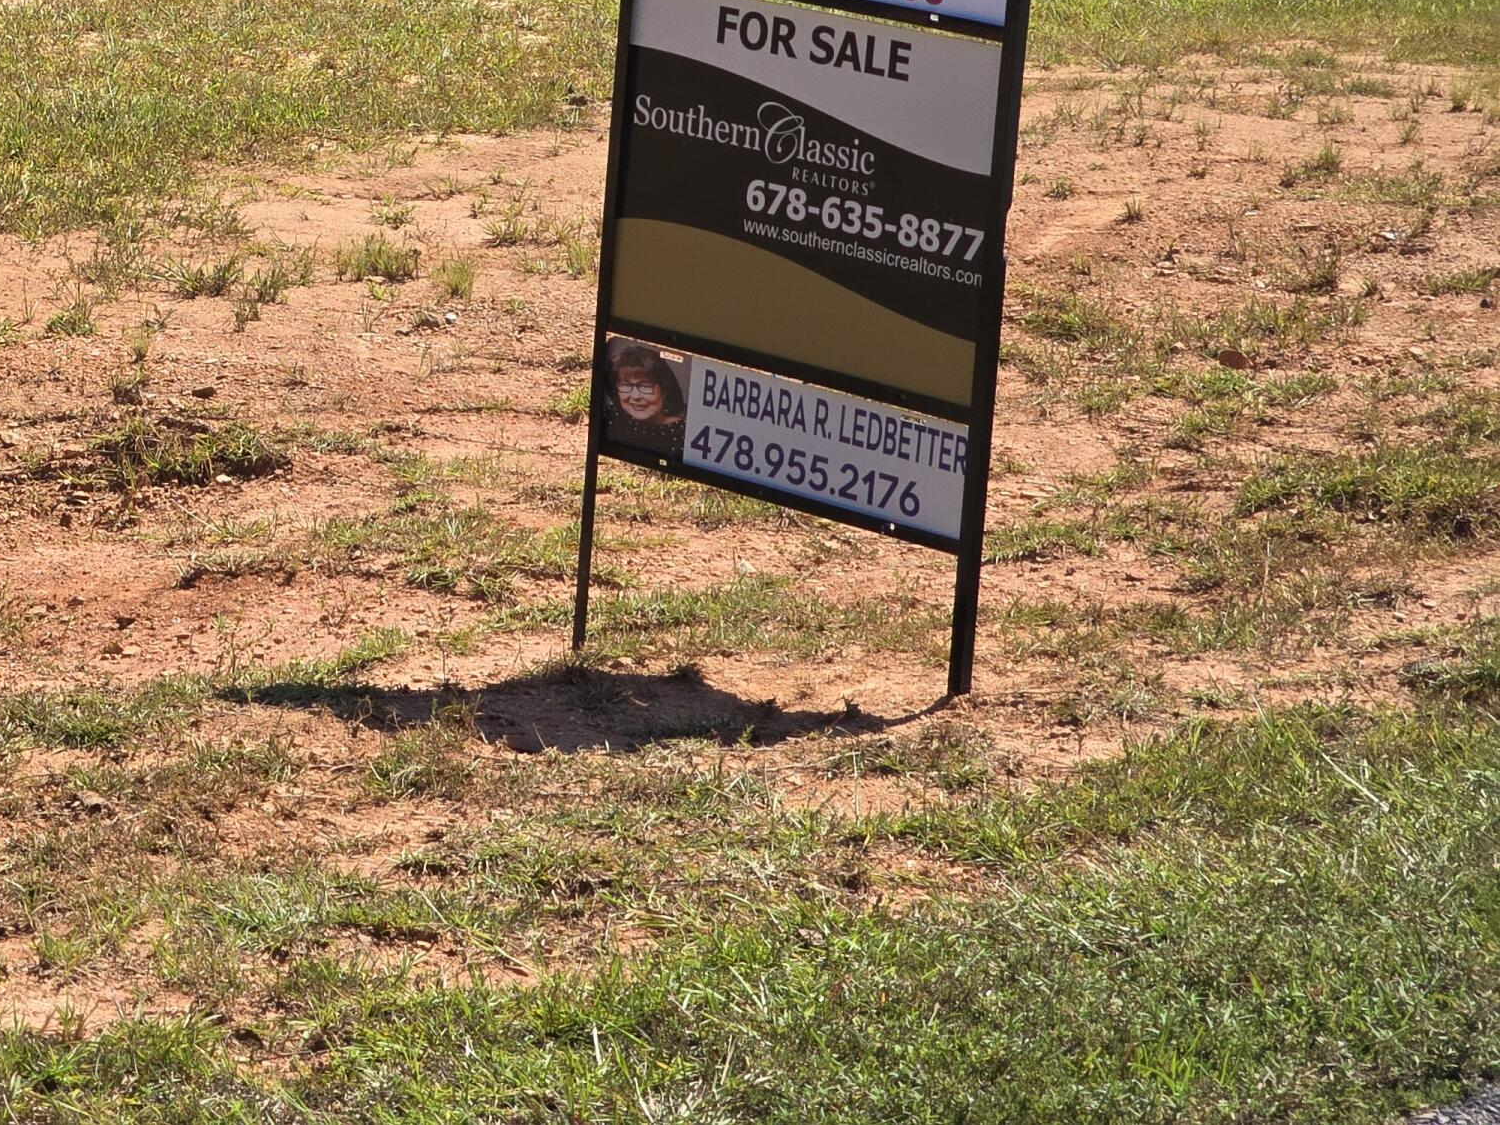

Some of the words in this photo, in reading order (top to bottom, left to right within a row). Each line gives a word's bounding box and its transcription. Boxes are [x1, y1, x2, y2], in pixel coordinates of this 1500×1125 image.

[716, 6, 797, 59] FOR
[808, 25, 912, 82] SALE
[633, 94, 761, 151] Southern
[757, 101, 876, 175] Classic
[746, 179, 985, 262] 678-635-8877
[702, 369, 806, 431] BARBARA
[813, 398, 832, 440] R.
[839, 404, 967, 475] LEDBETTER
[690, 425, 920, 517] 478.955.2176
